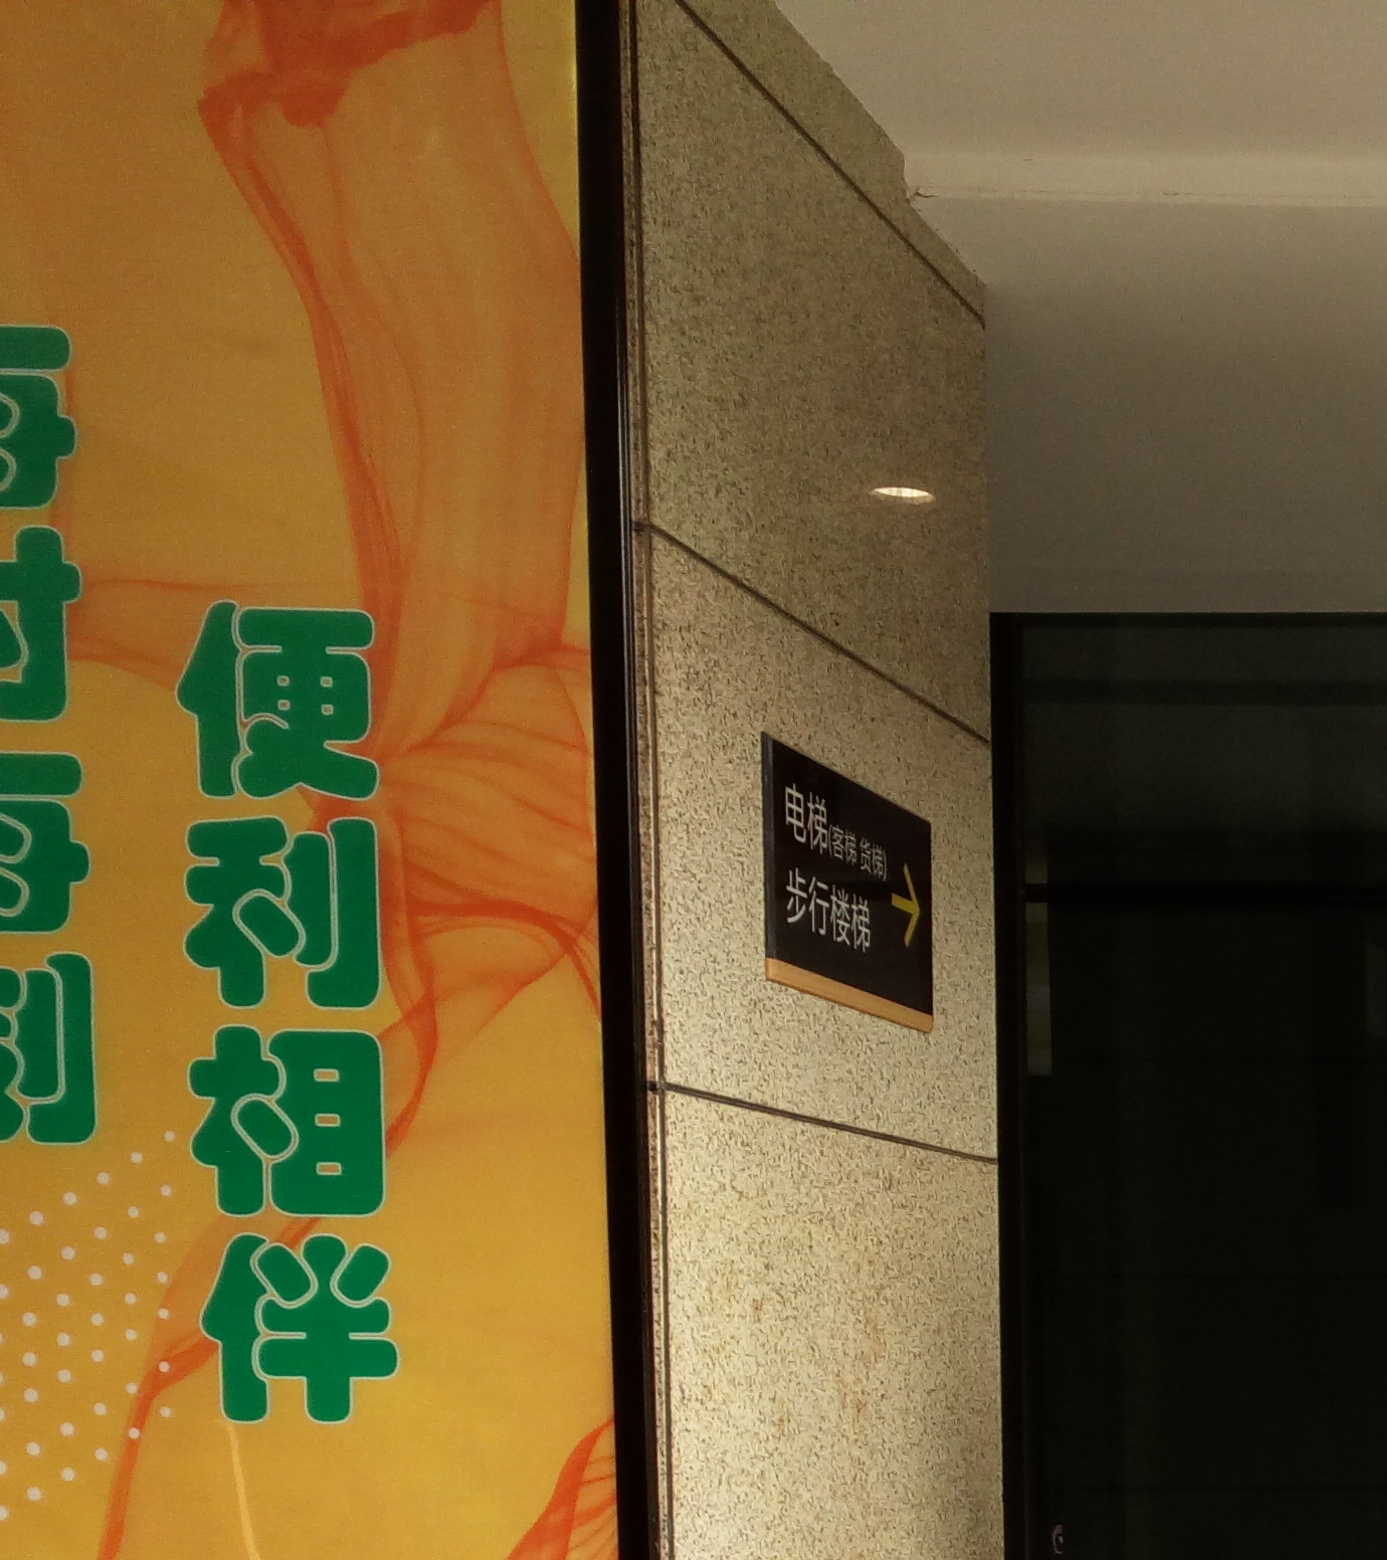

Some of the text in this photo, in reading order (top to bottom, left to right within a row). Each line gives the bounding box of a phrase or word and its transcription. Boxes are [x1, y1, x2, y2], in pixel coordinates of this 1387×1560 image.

[177, 600, 398, 1424] 便利相伴
[786, 867, 871, 953] 步行楼梯
